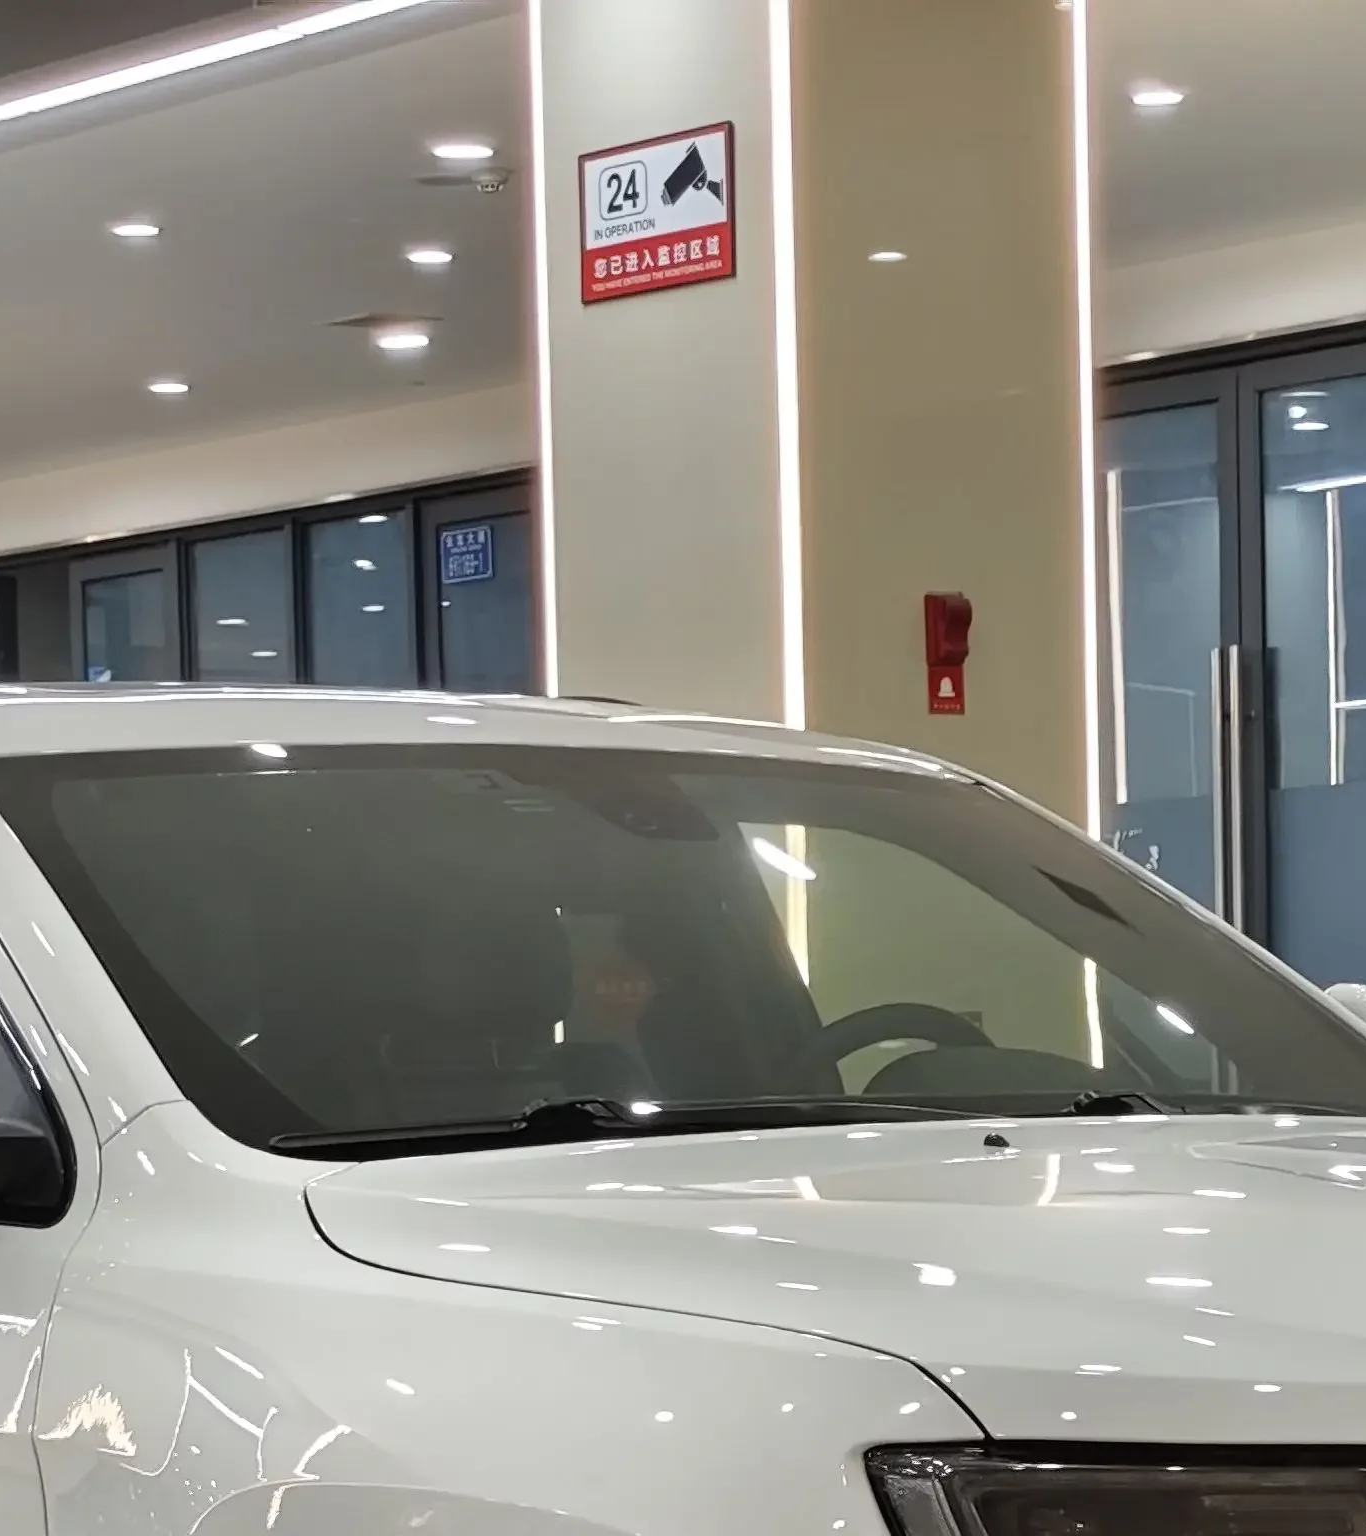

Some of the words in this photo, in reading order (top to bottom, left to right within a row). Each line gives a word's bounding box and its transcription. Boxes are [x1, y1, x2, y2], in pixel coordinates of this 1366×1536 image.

[606, 168, 640, 214] 24
[593, 228, 603, 241] IN
[603, 217, 656, 238] OPERATION
